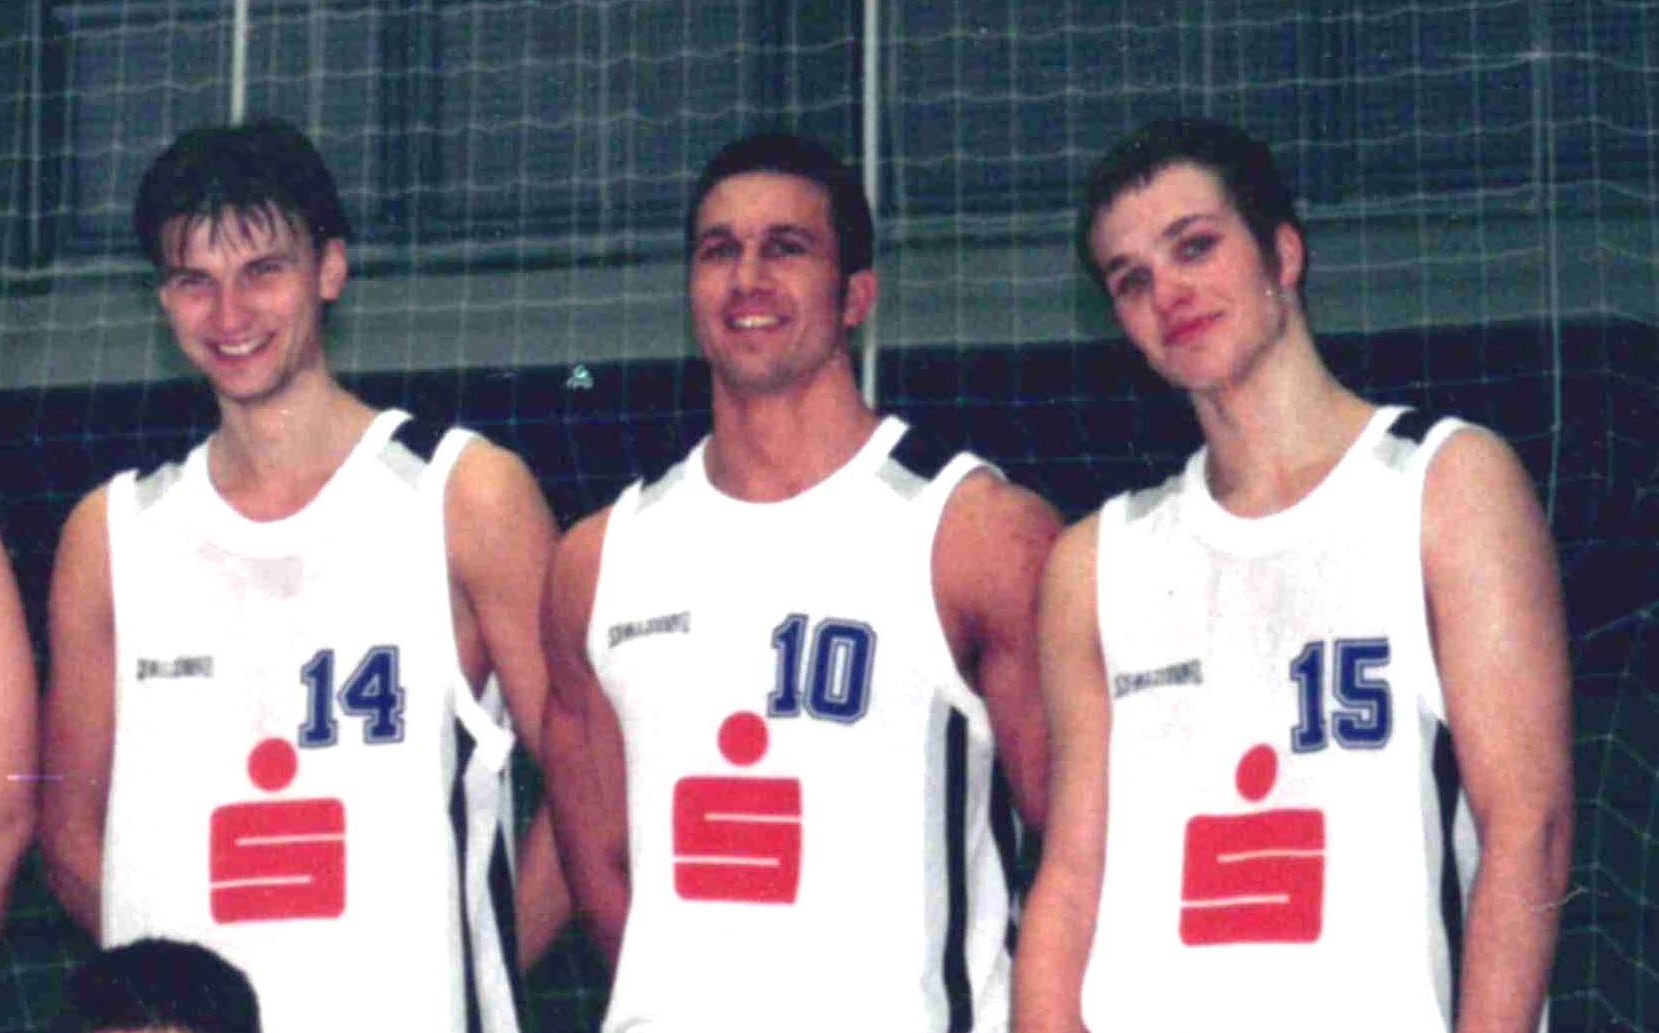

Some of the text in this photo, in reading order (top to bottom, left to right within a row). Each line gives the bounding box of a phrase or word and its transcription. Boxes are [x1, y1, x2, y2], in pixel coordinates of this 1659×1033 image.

[298, 645, 404, 748] 14
[768, 612, 877, 725] 10
[1290, 637, 1393, 754] 15
